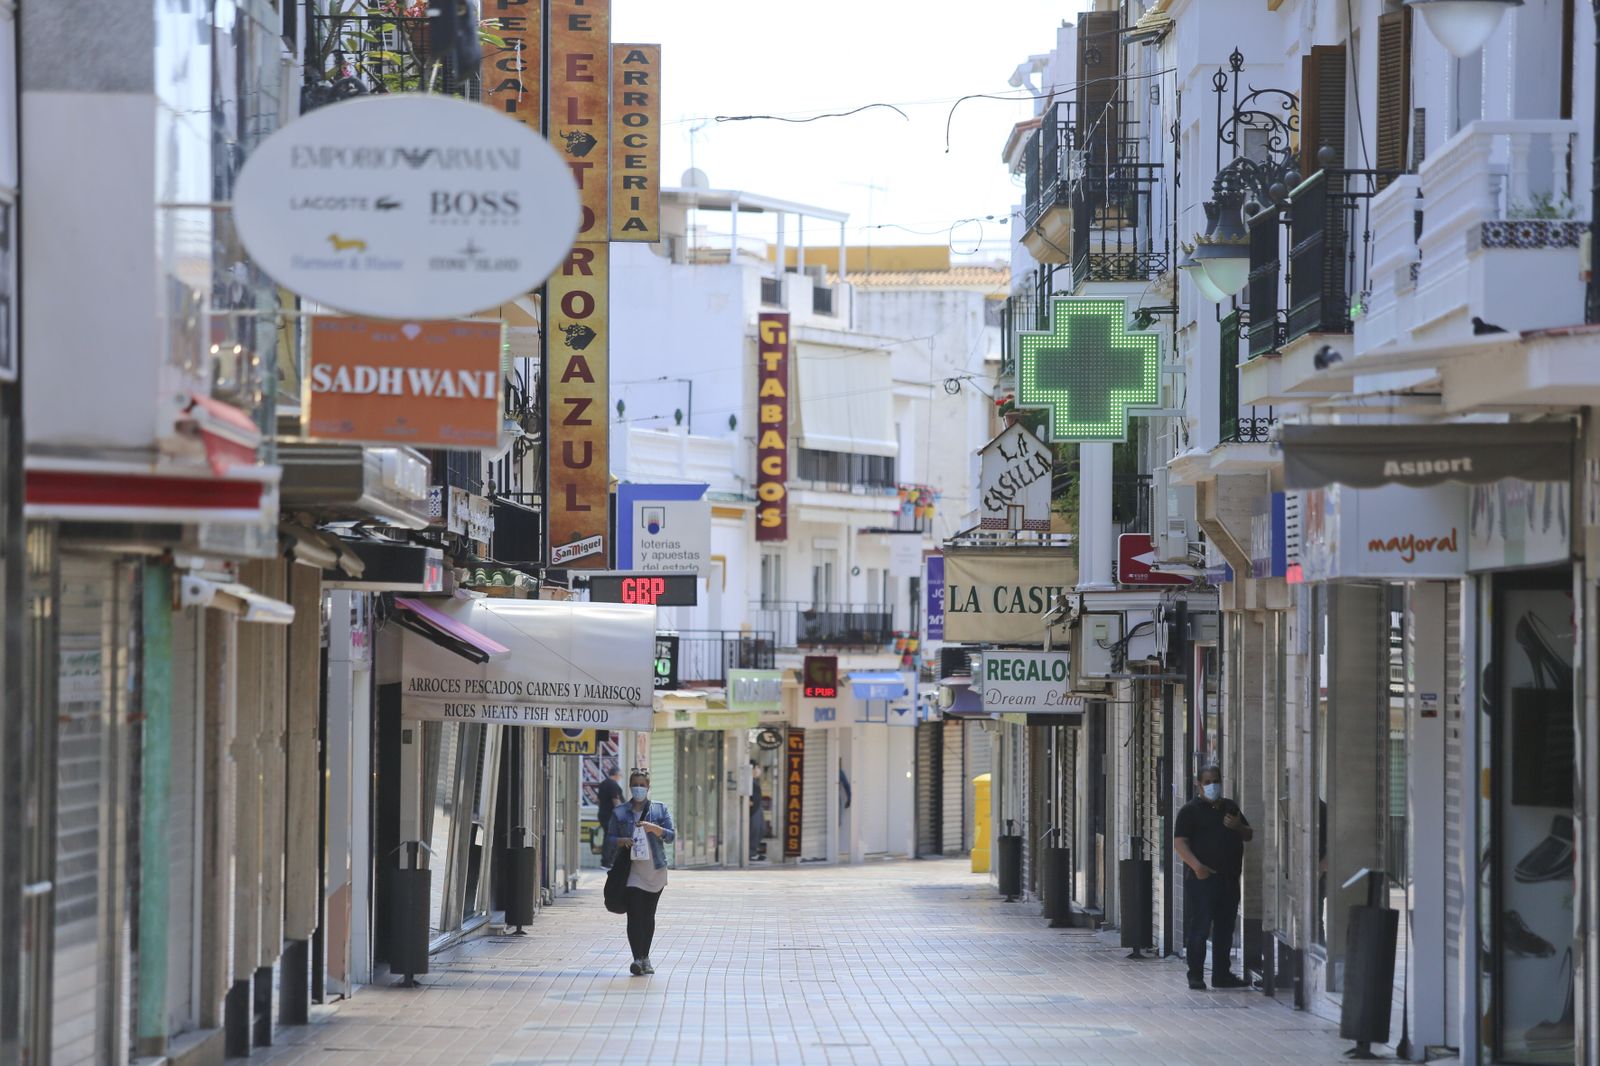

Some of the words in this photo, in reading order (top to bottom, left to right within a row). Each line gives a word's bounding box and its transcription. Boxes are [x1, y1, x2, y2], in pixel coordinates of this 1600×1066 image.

[566, 54, 594, 125] EL
[622, 50, 650, 232] ARROCERIA
[290, 197, 369, 211] LACOSTE
[430, 191, 521, 216] BOSS
[312, 364, 498, 399] SADHWANI
[561, 355, 595, 512] AZUL
[759, 352, 785, 528] TABACOS
[997, 433, 1029, 462] LA
[1384, 458, 1472, 476] Asport
[984, 451, 1053, 512] CASILLA
[641, 553, 648, 561] y
[652, 551, 700, 560] apuestas
[1368, 528, 1457, 563] mayoral
[622, 577, 665, 605] GBP
[948, 585, 982, 612] LA
[993, 586, 1076, 614] CASIL
[987, 659, 1070, 682] REGALO
[408, 678, 461, 693] ARROCES
[465, 680, 522, 696] PESCADOS
[526, 682, 570, 698] CARNES
[573, 684, 581, 698] Y
[584, 684, 641, 702] MARISCOS
[986, 688, 1036, 705] Dream
[444, 703, 476, 717] RICES
[481, 705, 518, 719] MEATS
[524, 707, 549, 721] FISH
[556, 741, 589, 753] ATM
[788, 757, 801, 849] TABACOS
